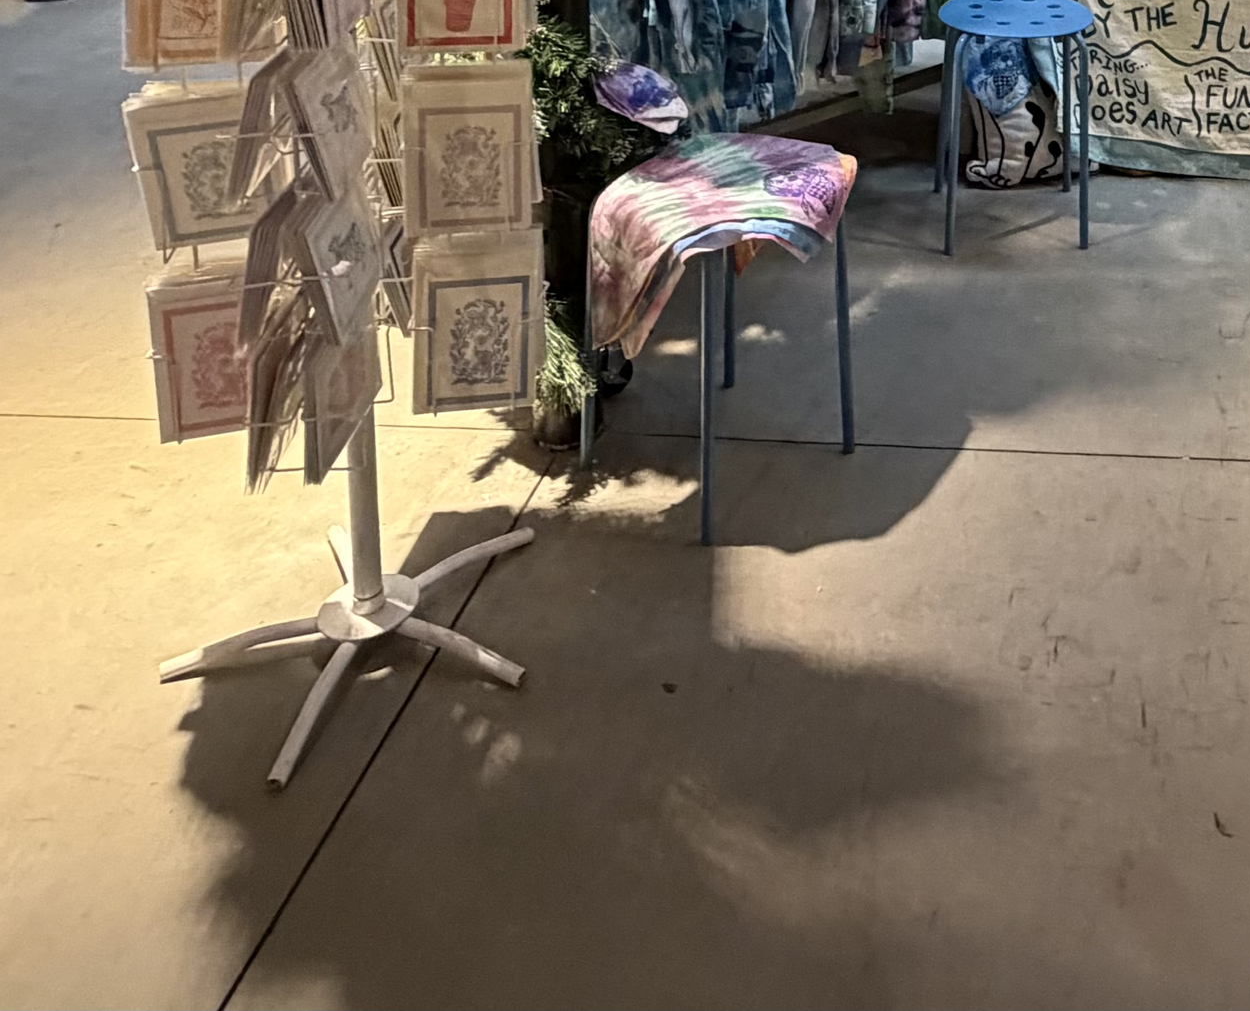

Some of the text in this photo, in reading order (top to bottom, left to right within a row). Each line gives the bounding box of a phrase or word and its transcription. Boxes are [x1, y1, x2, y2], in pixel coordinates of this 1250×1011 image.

[1124, 1, 1178, 33] THE
[1194, 66, 1229, 83] THE
[1141, 109, 1193, 137] ART
